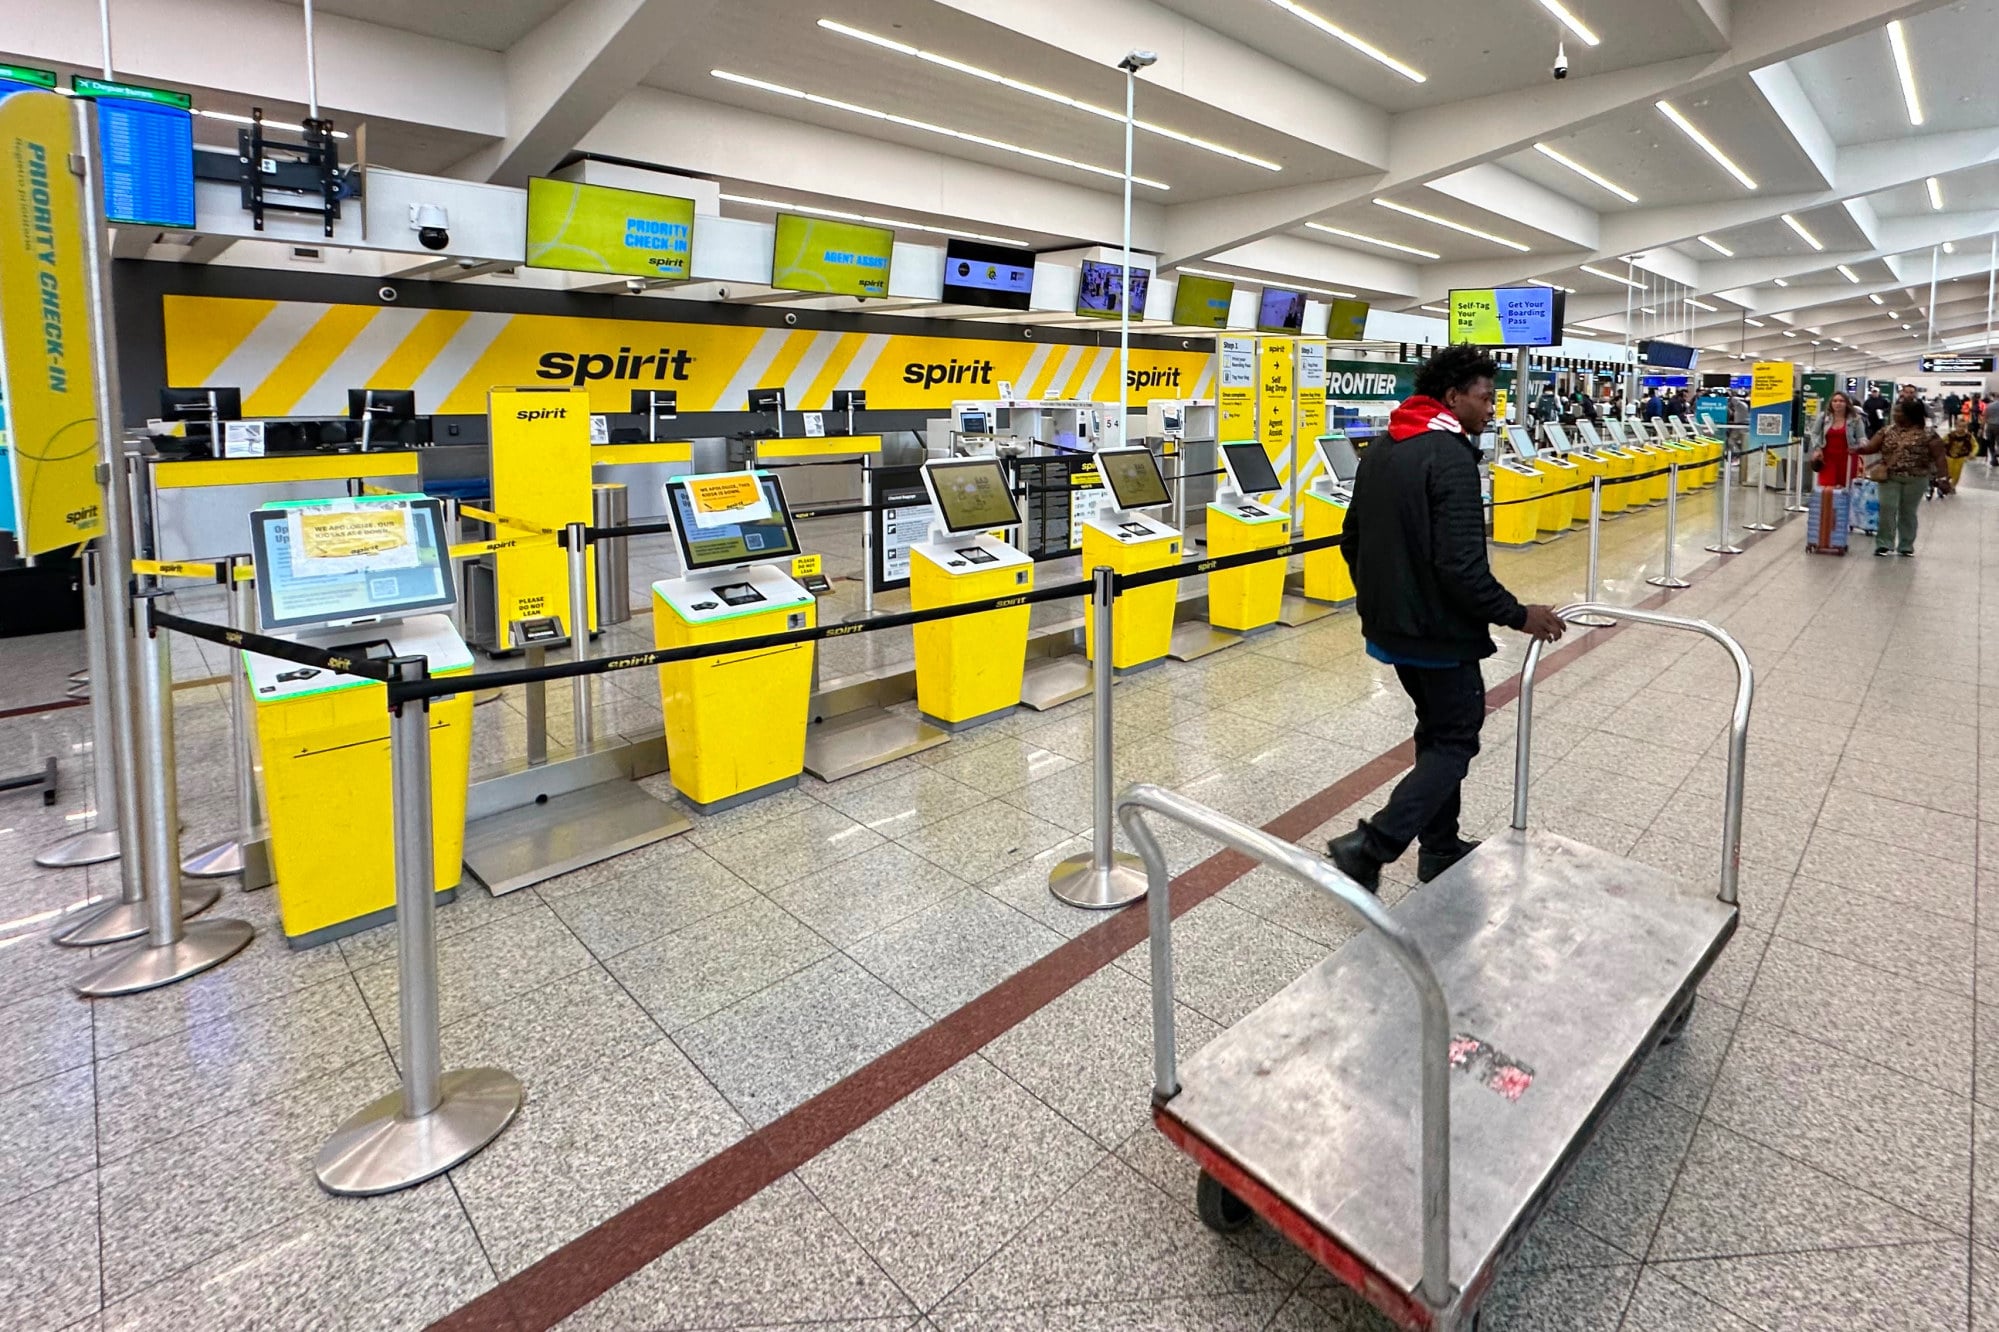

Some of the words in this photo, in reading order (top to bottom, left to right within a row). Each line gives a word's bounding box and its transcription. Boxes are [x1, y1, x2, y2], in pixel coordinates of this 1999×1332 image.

[28, 142, 56, 266] PRIORITY
[626, 218, 689, 237] PRIORITY
[624, 233, 688, 252] CHECK-IN
[648, 257, 684, 268] spirit
[823, 251, 854, 265] AGENT
[856, 255, 888, 270] ASSIST
[858, 278, 884, 288] spirit
[1458, 302, 1490, 310] Self-Tag
[1508, 309, 1546, 317] Boarding
[40, 271, 67, 393] CHECK-IN
[1223, 341, 1234, 350] Step
[1269, 345, 1285, 353] spirit
[536, 347, 692, 386] spirit
[902, 359, 993, 390] spirit
[1125, 366, 1181, 391] spirit
[1271, 376, 1281, 384] Self
[1848, 378, 1856, 386] 2
[1265, 385, 1275, 393] Bag
[1275, 385, 1287, 393] Drop
[516, 407, 568, 422] spirit
[1106, 419, 1111, 428] 5
[1114, 419, 1119, 428] 4
[1268, 420, 1283, 428] Agent
[66, 505, 98, 524] spirit
[487, 540, 517, 551] spirit
[159, 564, 183, 573] spirit
[1197, 559, 1217, 572] spirit
[518, 596, 545, 604] PLEASE
[995, 597, 1027, 608] spirit
[530, 602, 545, 610] NOT
[522, 609, 541, 617] LEAN
[825, 624, 864, 637] spirit
[328, 657, 352, 670] spirit
[607, 653, 656, 669] spirit
